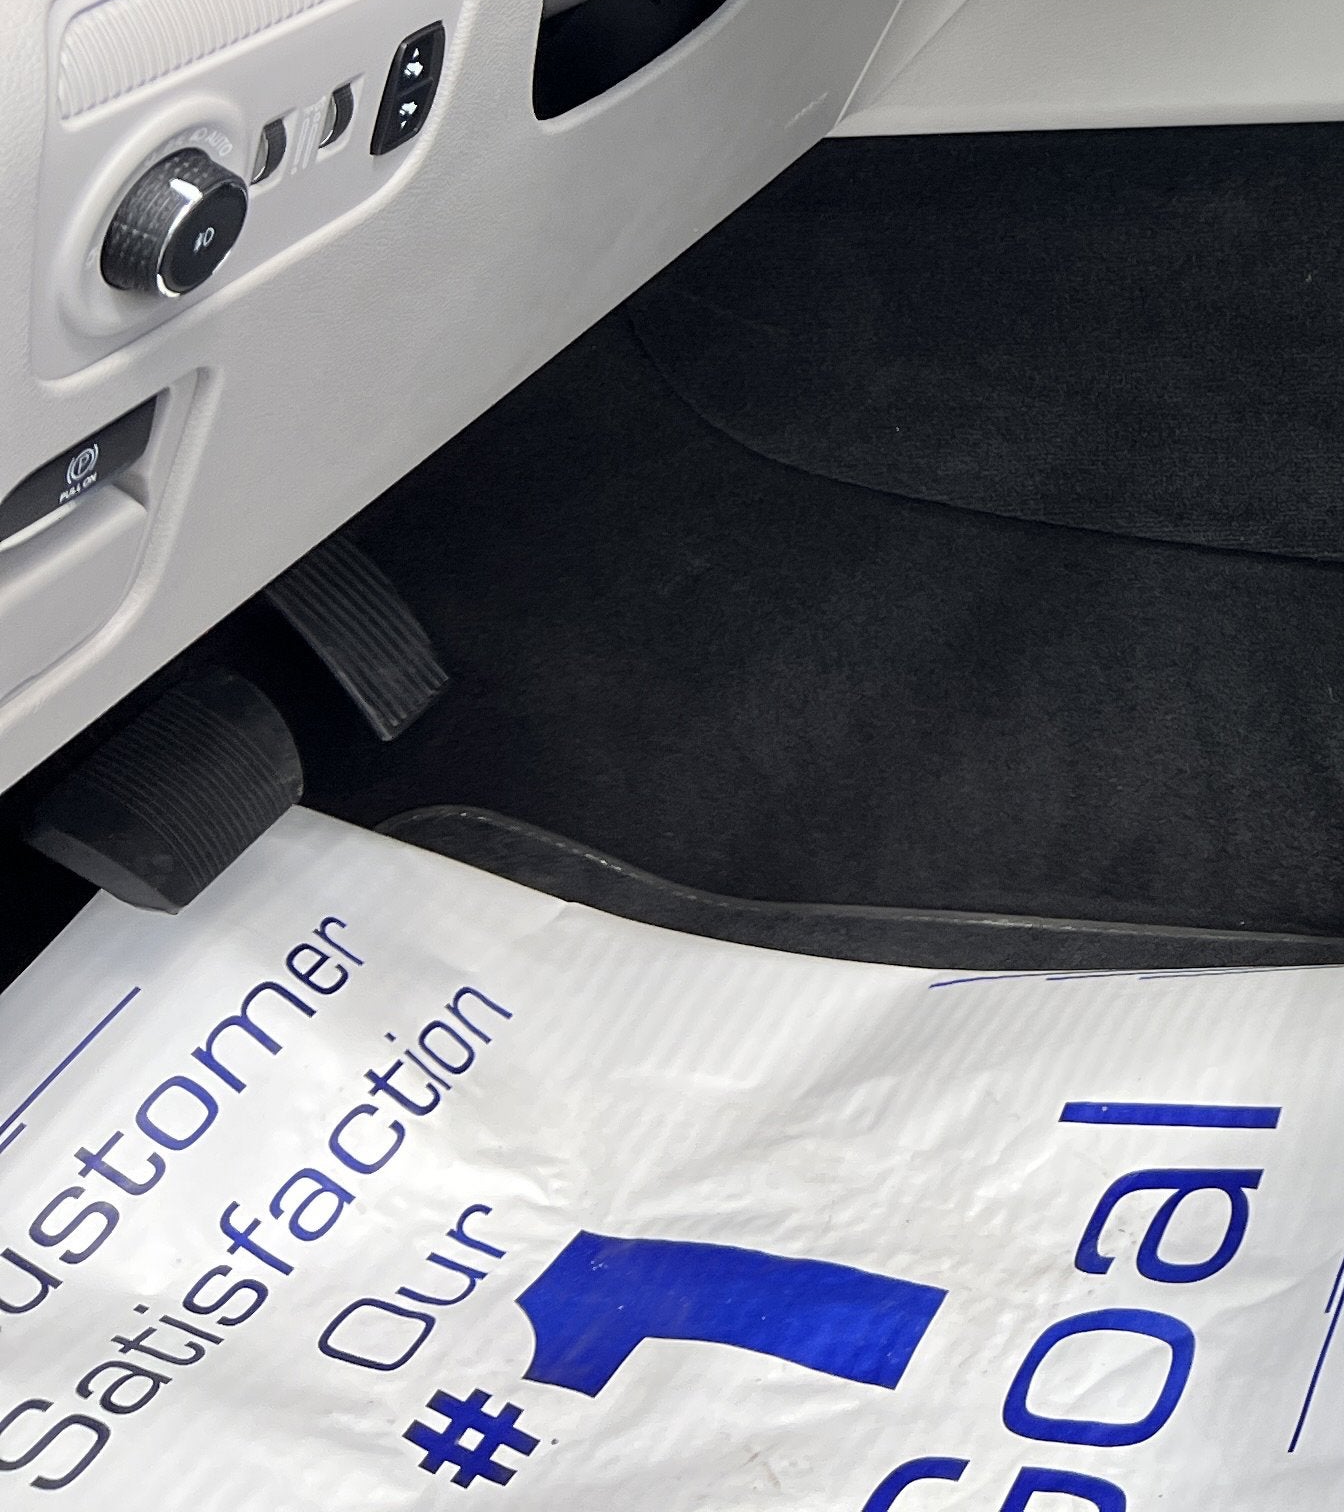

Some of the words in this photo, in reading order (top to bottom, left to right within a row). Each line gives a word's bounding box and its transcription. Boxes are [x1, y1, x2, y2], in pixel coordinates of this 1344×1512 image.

[0, 916, 364, 1314] ustomer
[0, 986, 513, 1490] Satisfaction
[318, 1203, 507, 1372] Our
[402, 1229, 948, 1489] #1
